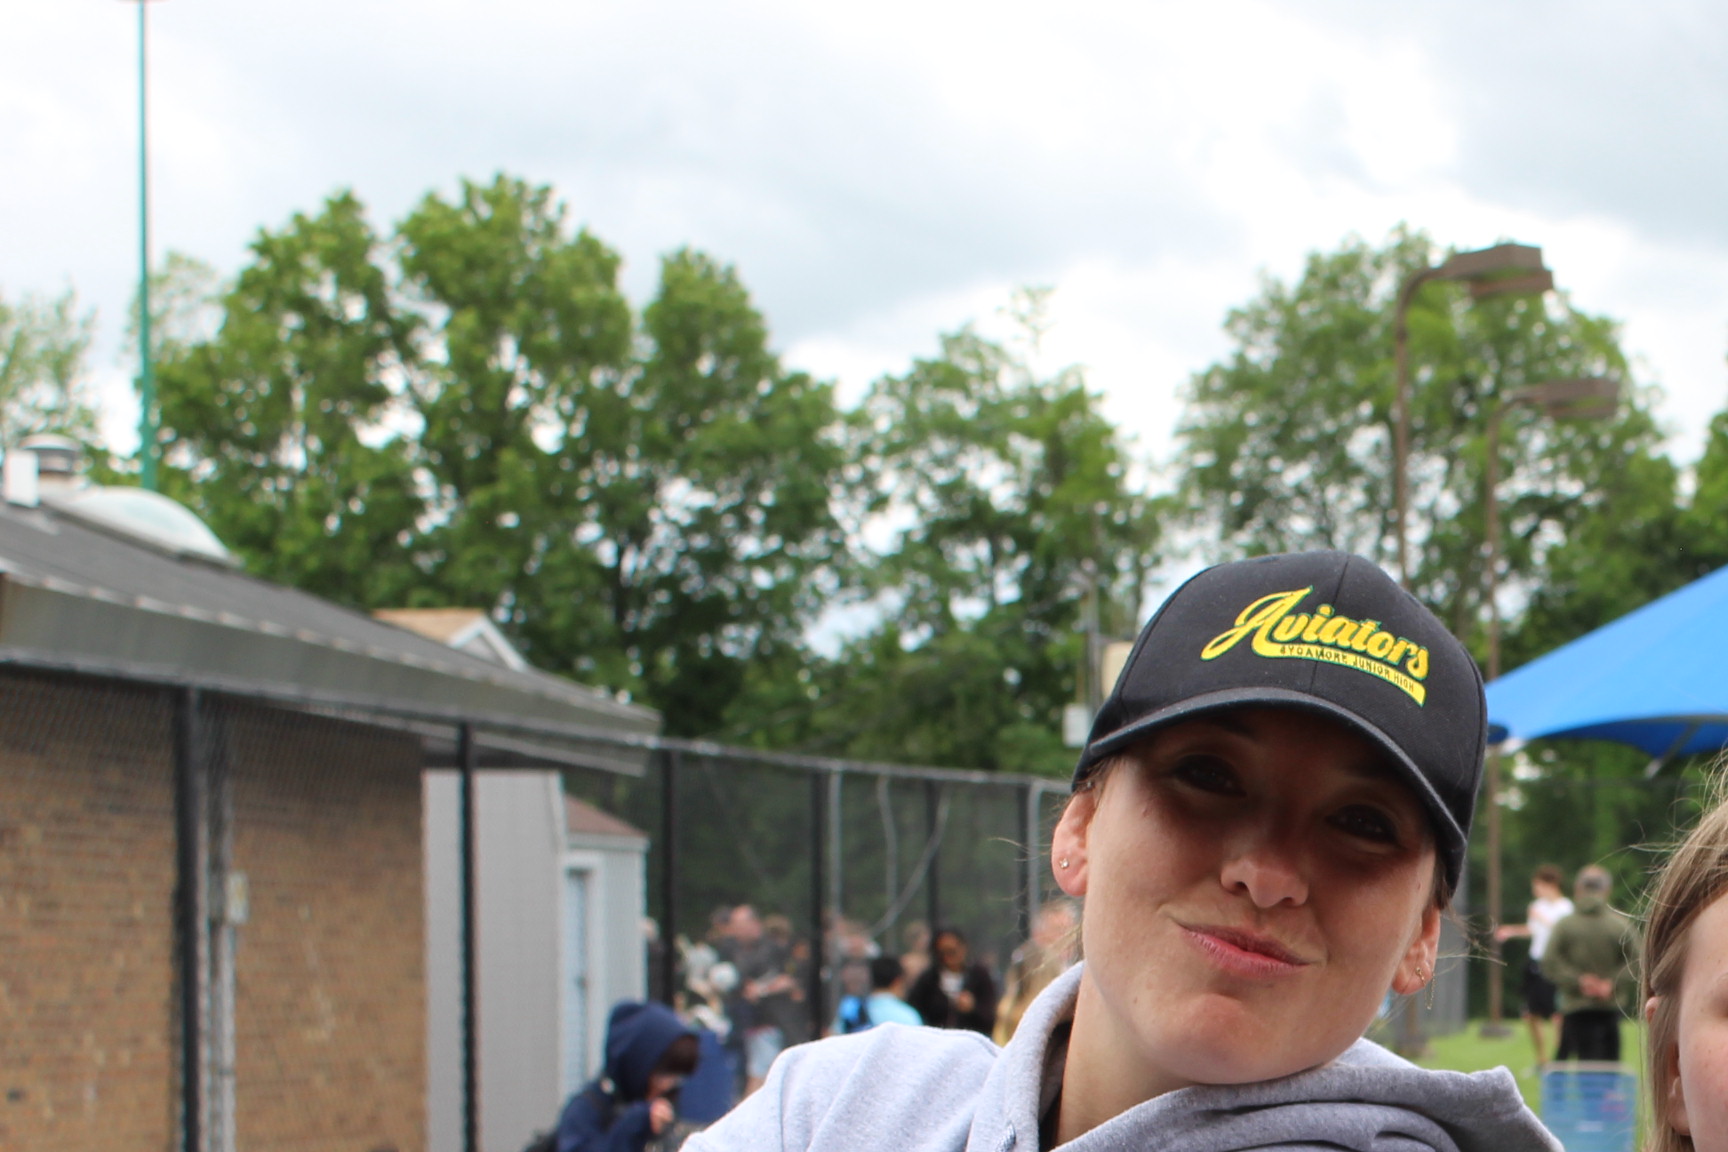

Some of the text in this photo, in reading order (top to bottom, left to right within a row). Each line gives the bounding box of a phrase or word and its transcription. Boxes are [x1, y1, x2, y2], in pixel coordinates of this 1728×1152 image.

[1201, 585, 1429, 681] Aviators
[1353, 656, 1390, 679] JUNIOR
[1393, 671, 1415, 693] HIGH
